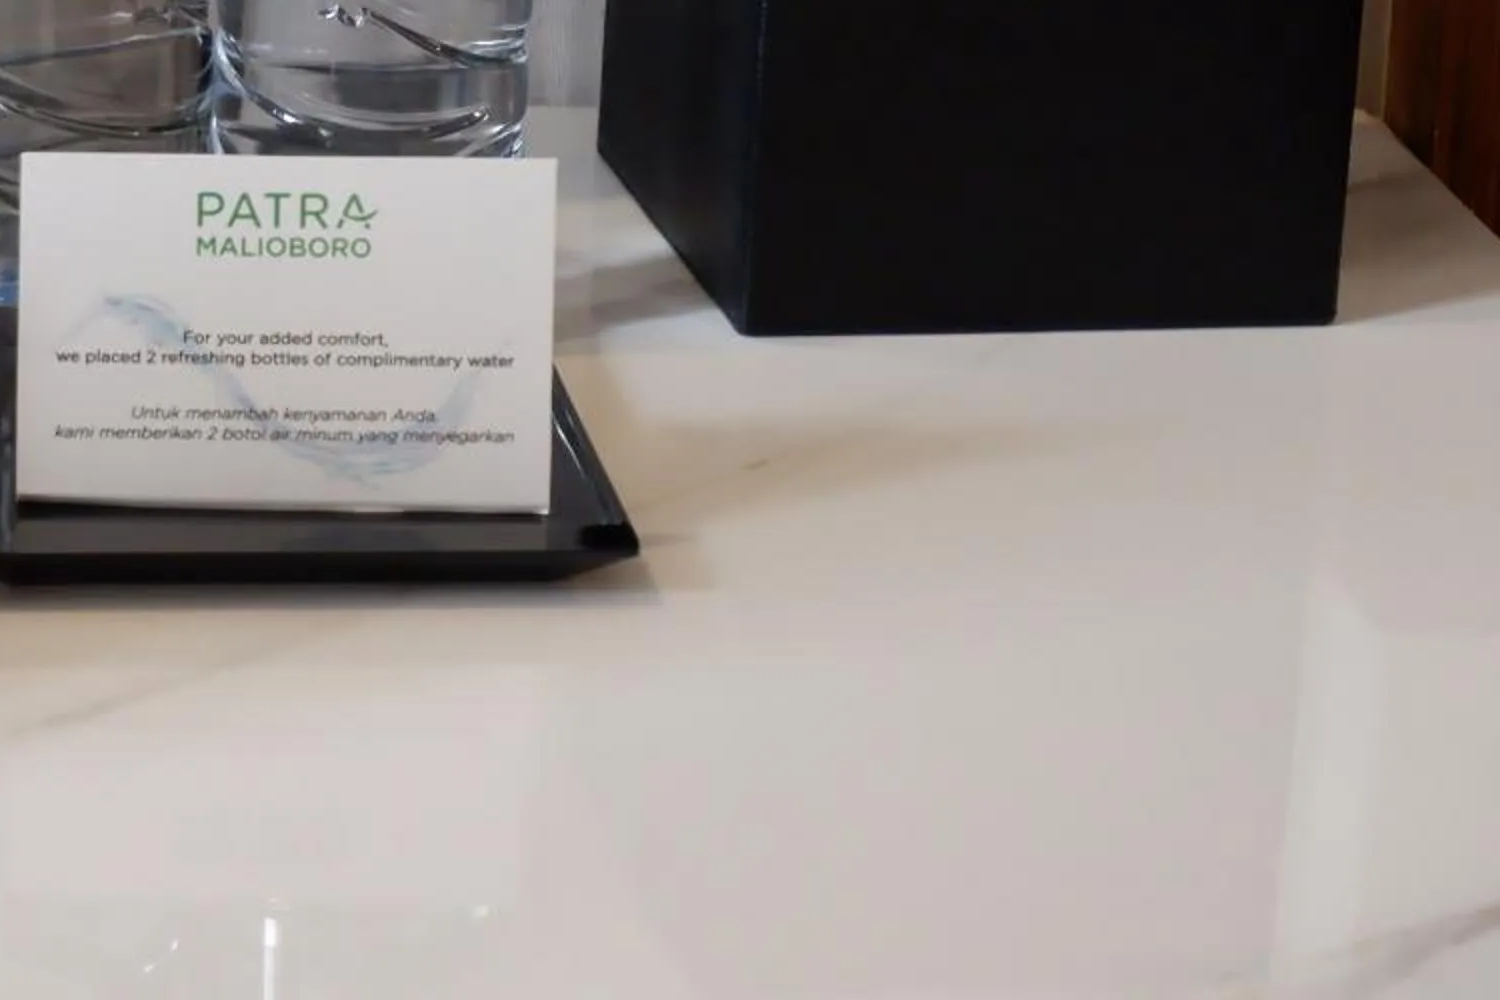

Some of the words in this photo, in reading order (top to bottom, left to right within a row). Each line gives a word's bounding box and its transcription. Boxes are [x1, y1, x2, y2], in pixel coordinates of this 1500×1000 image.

[196, 191, 378, 230] PATRA
[195, 236, 372, 260] MALIOBORO
[183, 330, 210, 345] For
[217, 334, 254, 348] your
[260, 331, 312, 346] added
[318, 332, 389, 348] comfort,
[55, 353, 80, 364] we
[85, 350, 141, 366] placed
[147, 351, 157, 364] 2
[161, 351, 245, 368] refreshing
[251, 352, 309, 366] bottles
[314, 352, 331, 367] of
[336, 353, 462, 371] complimentary
[468, 356, 515, 368] water
[132, 406, 181, 420] Untuk
[186, 406, 278, 421] menambah
[284, 408, 387, 424] kenyamanan
[55, 425, 94, 440] kami
[99, 427, 202, 440] memberikan
[207, 427, 218, 440] 2
[222, 426, 266, 441] botol
[270, 428, 290, 440] air
[295, 430, 352, 442] minum
[358, 431, 398, 445] yang
[403, 430, 515, 446] menyegarkan
